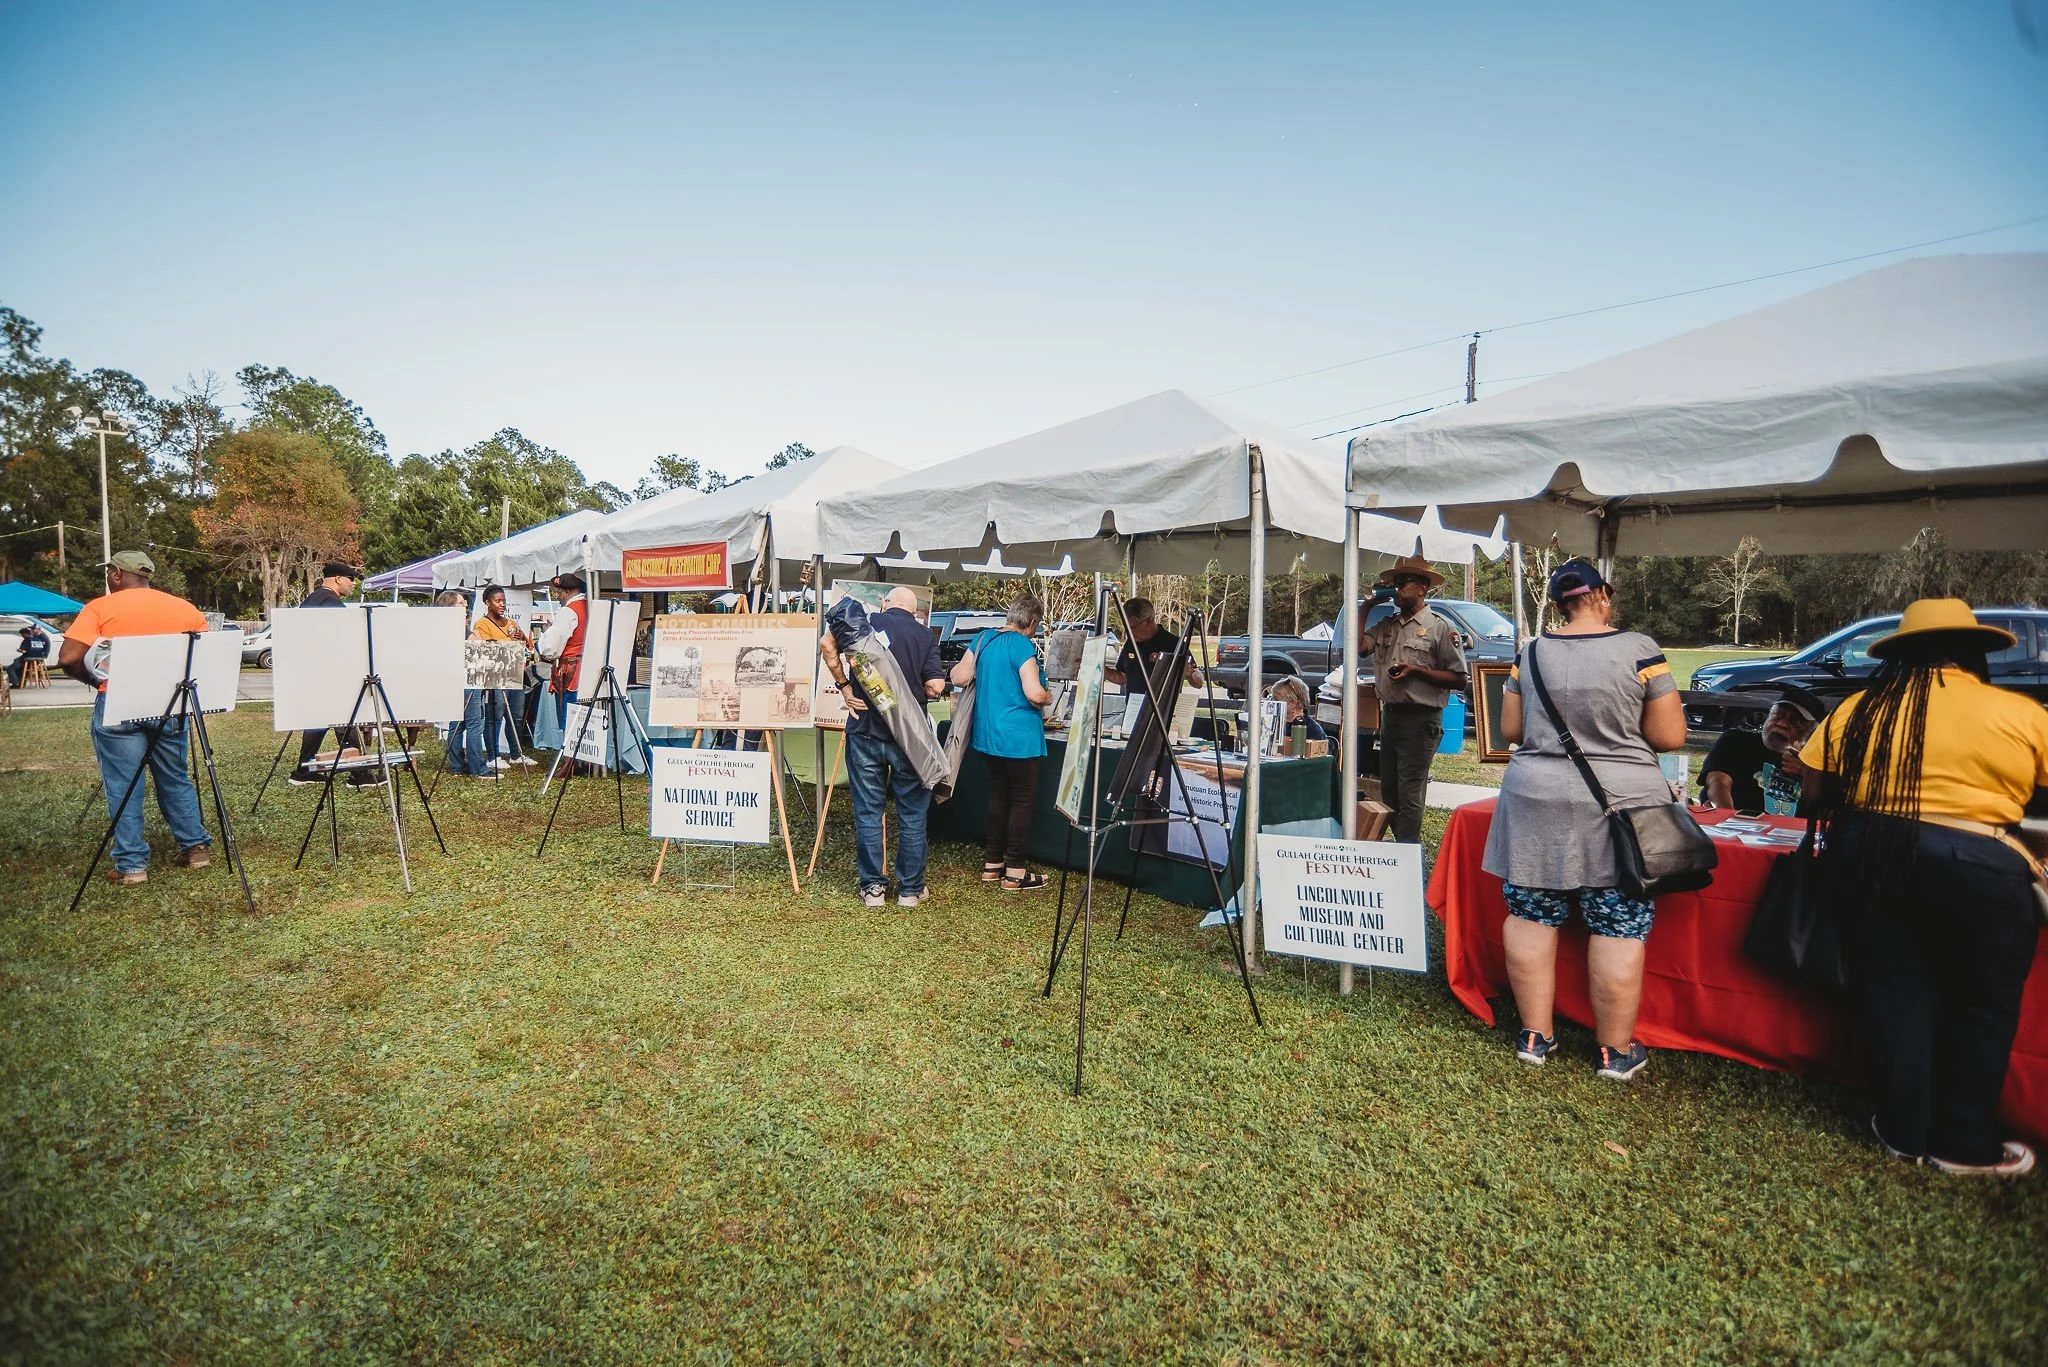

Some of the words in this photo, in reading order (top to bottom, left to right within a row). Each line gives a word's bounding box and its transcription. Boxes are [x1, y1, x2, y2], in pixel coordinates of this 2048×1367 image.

[626, 559, 641, 578] COSMO
[642, 557, 668, 577] HISTORICAL
[669, 554, 705, 577] PRESERVATION
[706, 553, 722, 575] CORP.
[711, 618, 788, 629] FAMILIES
[815, 716, 839, 724] Kingsley
[577, 727, 595, 741] CSMO
[570, 740, 599, 757] COMUNITY
[688, 766, 737, 778] FESTIVAL
[724, 761, 755, 769] HERITAGE
[664, 787, 720, 806] NATIONAL
[726, 791, 758, 808] PARK
[1191, 796, 1212, 806] Historic
[1208, 788, 1238, 799] Ecoloical
[685, 809, 735, 828] SERVICE
[1277, 849, 1311, 860] GULLAH
[1313, 852, 1351, 863] GEECHEE
[1354, 855, 1399, 867] HERITAGE
[1305, 861, 1375, 879] FESTIVAL
[1297, 884, 1385, 909] LINCOLNVILLE
[1299, 905, 1354, 928] MUSEUM
[1359, 912, 1384, 931] AND
[1284, 924, 1348, 949] CULTURAL
[1353, 932, 1404, 955] CENTER
